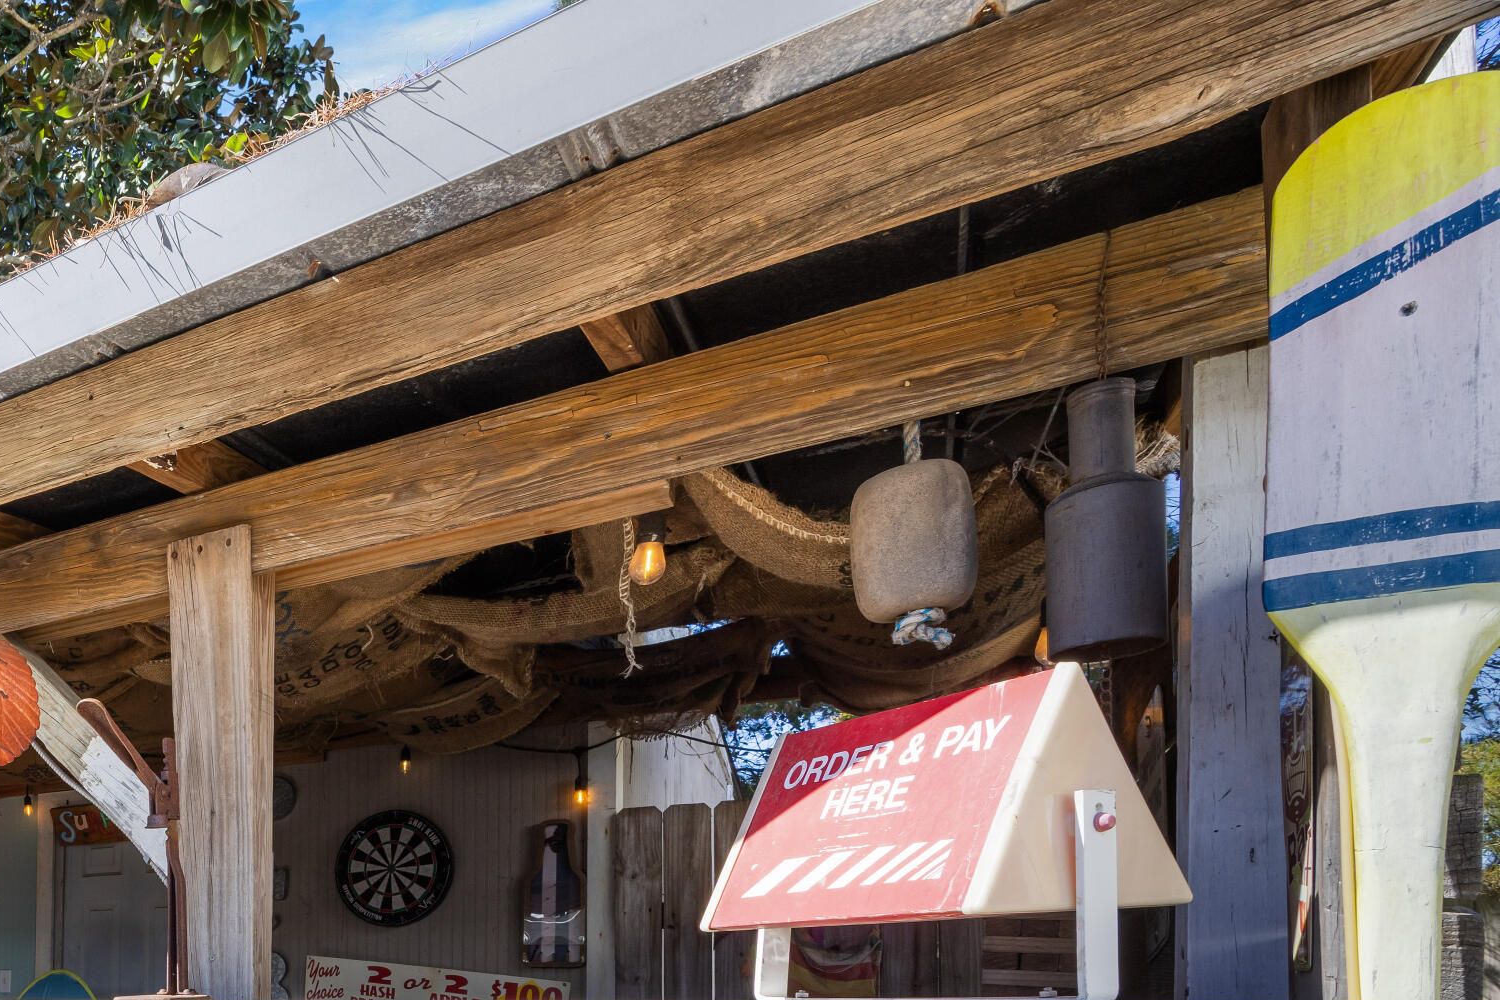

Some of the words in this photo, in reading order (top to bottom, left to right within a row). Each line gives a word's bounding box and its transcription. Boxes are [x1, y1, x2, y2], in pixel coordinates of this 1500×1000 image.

[784, 741, 894, 789] ORDER
[899, 733, 925, 765] &
[933, 715, 1012, 758] PAY
[820, 775, 915, 819] HERE
[424, 828, 441, 845] KING
[308, 960, 340, 978] Your
[306, 980, 344, 1000] choice
[367, 966, 392, 984] 2
[404, 978, 432, 990] or
[445, 975, 468, 994] 2
[360, 984, 396, 1000] HASH
